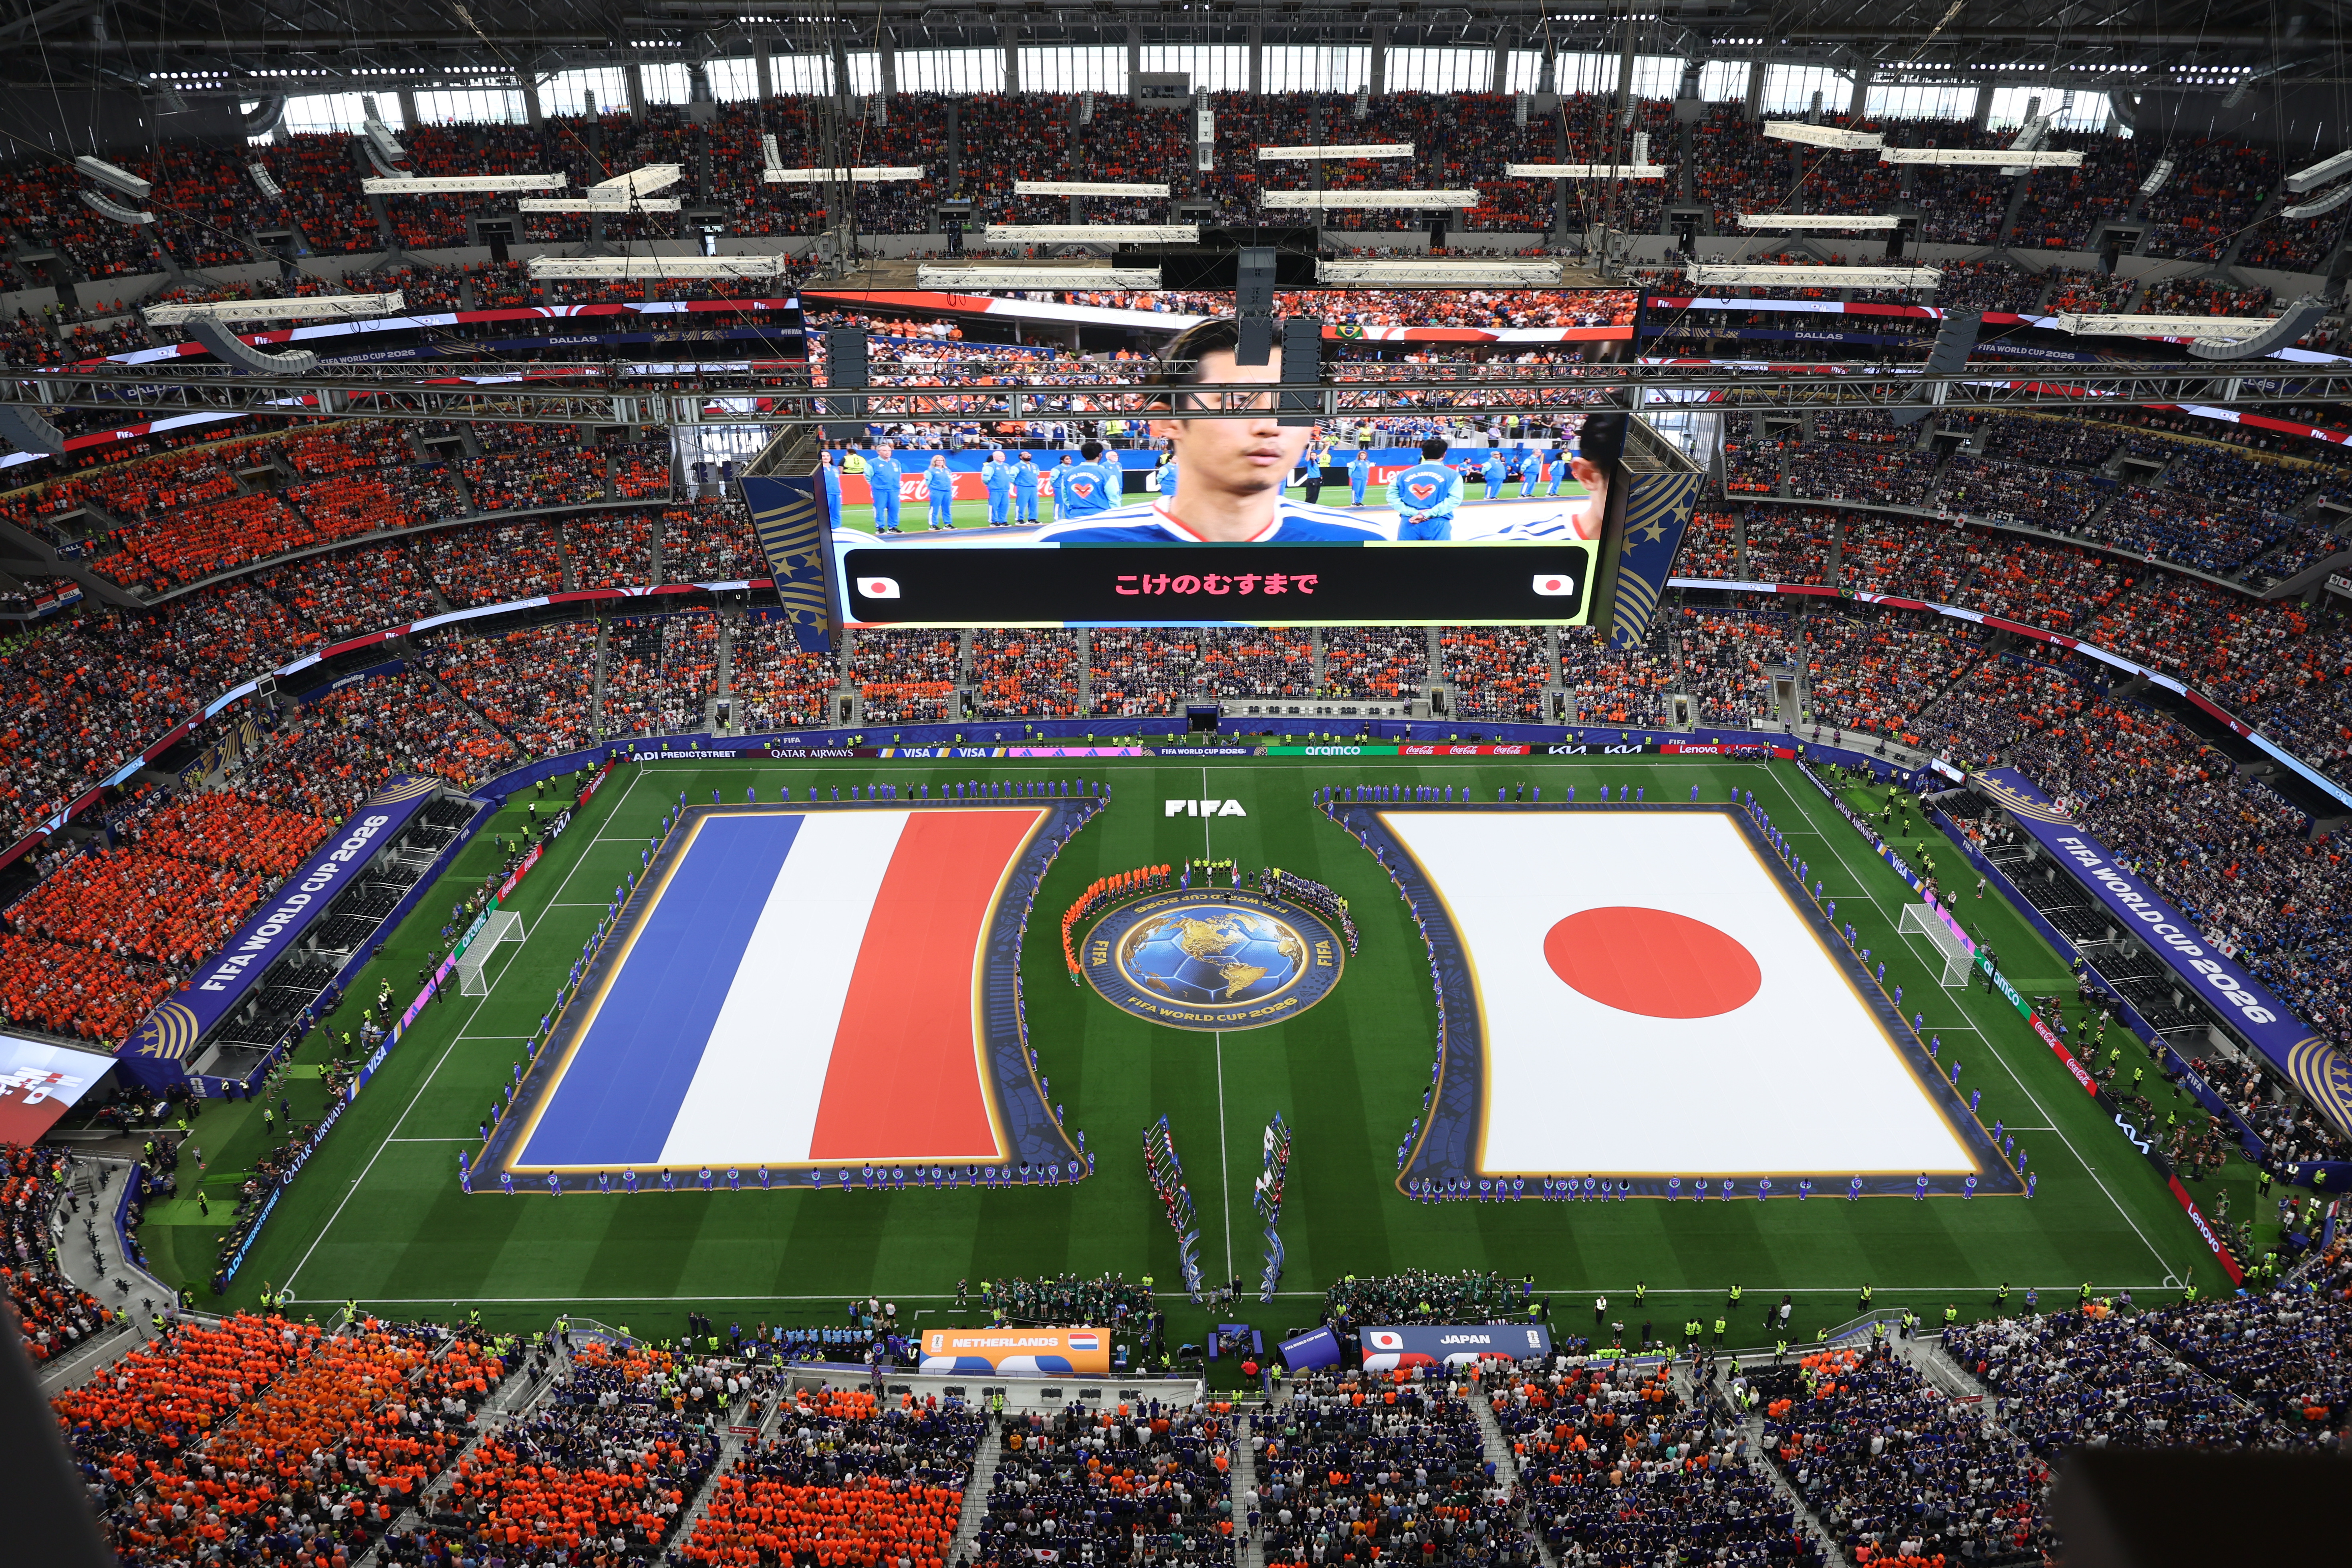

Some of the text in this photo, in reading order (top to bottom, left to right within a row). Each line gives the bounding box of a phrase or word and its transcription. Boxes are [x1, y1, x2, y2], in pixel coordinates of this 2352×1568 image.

[549, 336, 597, 344] DALLAS
[1795, 332, 1844, 340] DALLAS
[339, 354, 369, 363] WORLD
[371, 352, 386, 360] CUP
[387, 349, 416, 359] 2026
[1997, 346, 2026, 355] WORLD
[2028, 348, 2044, 356] CUP
[2046, 351, 2075, 360] 2026
[1067, 472, 1100, 483] VOLUNTEER
[1404, 472, 1445, 483] VOLUNTEER
[1115, 574, 1318, 595] こけのむすまで
[63, 590, 77, 599] MILL
[332, 673, 365, 689] #FIFAWorldCup
[633, 750, 736, 761] ADI PREDICTSTREET
[771, 748, 854, 758] QATAR AIRWAYS
[903, 748, 930, 757] VISA
[957, 748, 986, 757] VISA
[1305, 746, 1360, 755] aramco
[1405, 746, 1433, 755] Coca-Cola
[1449, 746, 1477, 755] Coca-Cola
[1493, 746, 1521, 755] Coca-Cola
[1548, 745, 1586, 754] KIA
[1604, 745, 1642, 754] KIA
[1679, 745, 1718, 754] Lenovo
[590, 773, 606, 794] Lenovo
[1797, 761, 1832, 798] ADI PREDICTSTREET
[1165, 800, 1246, 817] FIFA
[1834, 797, 1875, 844] QATAR AIRWAYS
[461, 828, 470, 841] FIFA
[1963, 840, 1972, 854] FIFA
[524, 850, 538, 872] Coca-Cola
[1892, 855, 1907, 879] VISA
[502, 873, 517, 898] Coca-Cola
[200, 815, 389, 991] FIFA WORLD CUP 2026
[1134, 897, 1179, 913] 2026
[2056, 837, 2276, 1023] FIFA WORLD CUP 2026
[1092, 940, 1109, 966] FIFA
[1316, 940, 1332, 966] FIFA
[1128, 997, 1298, 1022] FIFA WORLD CUP 2026
[2035, 1020, 2058, 1048] Coca-Cola
[369, 1046, 387, 1074] VISA
[2066, 1058, 2088, 1086] Coca-Cola
[2186, 1072, 2202, 1093] FIFA
[283, 1098, 346, 1184] QATAR AIRWAYS
[228, 1187, 280, 1281] ADI PREDICTSTREET
[2187, 1203, 2220, 1254] Lenovo
[953, 1337, 1058, 1347] NETHERLANDS
[1293, 1339, 1307, 1349] WORLD
[1314, 1331, 1328, 1339] 2026
[1440, 1335, 1490, 1344] JAPAN
